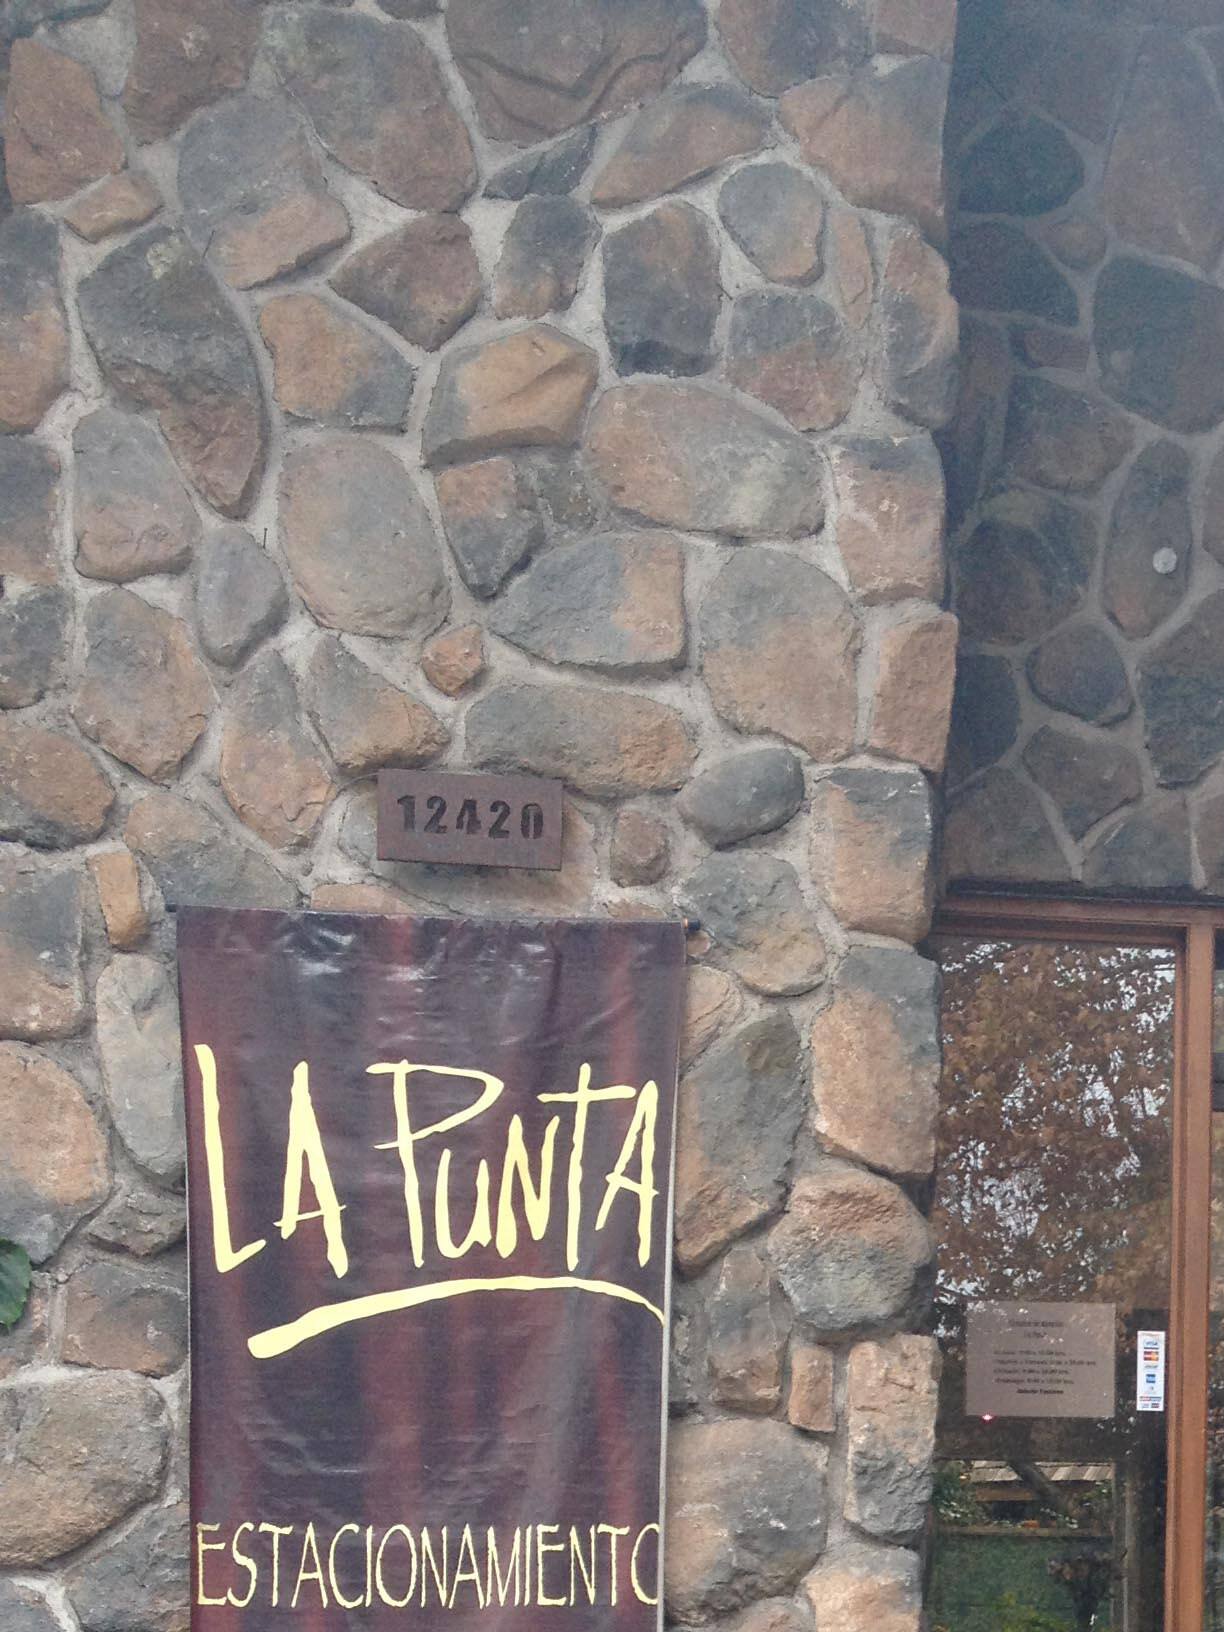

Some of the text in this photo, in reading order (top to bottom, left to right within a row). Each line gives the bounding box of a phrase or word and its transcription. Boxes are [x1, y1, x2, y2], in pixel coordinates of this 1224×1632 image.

[397, 795, 545, 840] 12420
[194, 1043, 349, 1279] LA
[196, 1522, 661, 1609] ESTACIONAMIENTO
